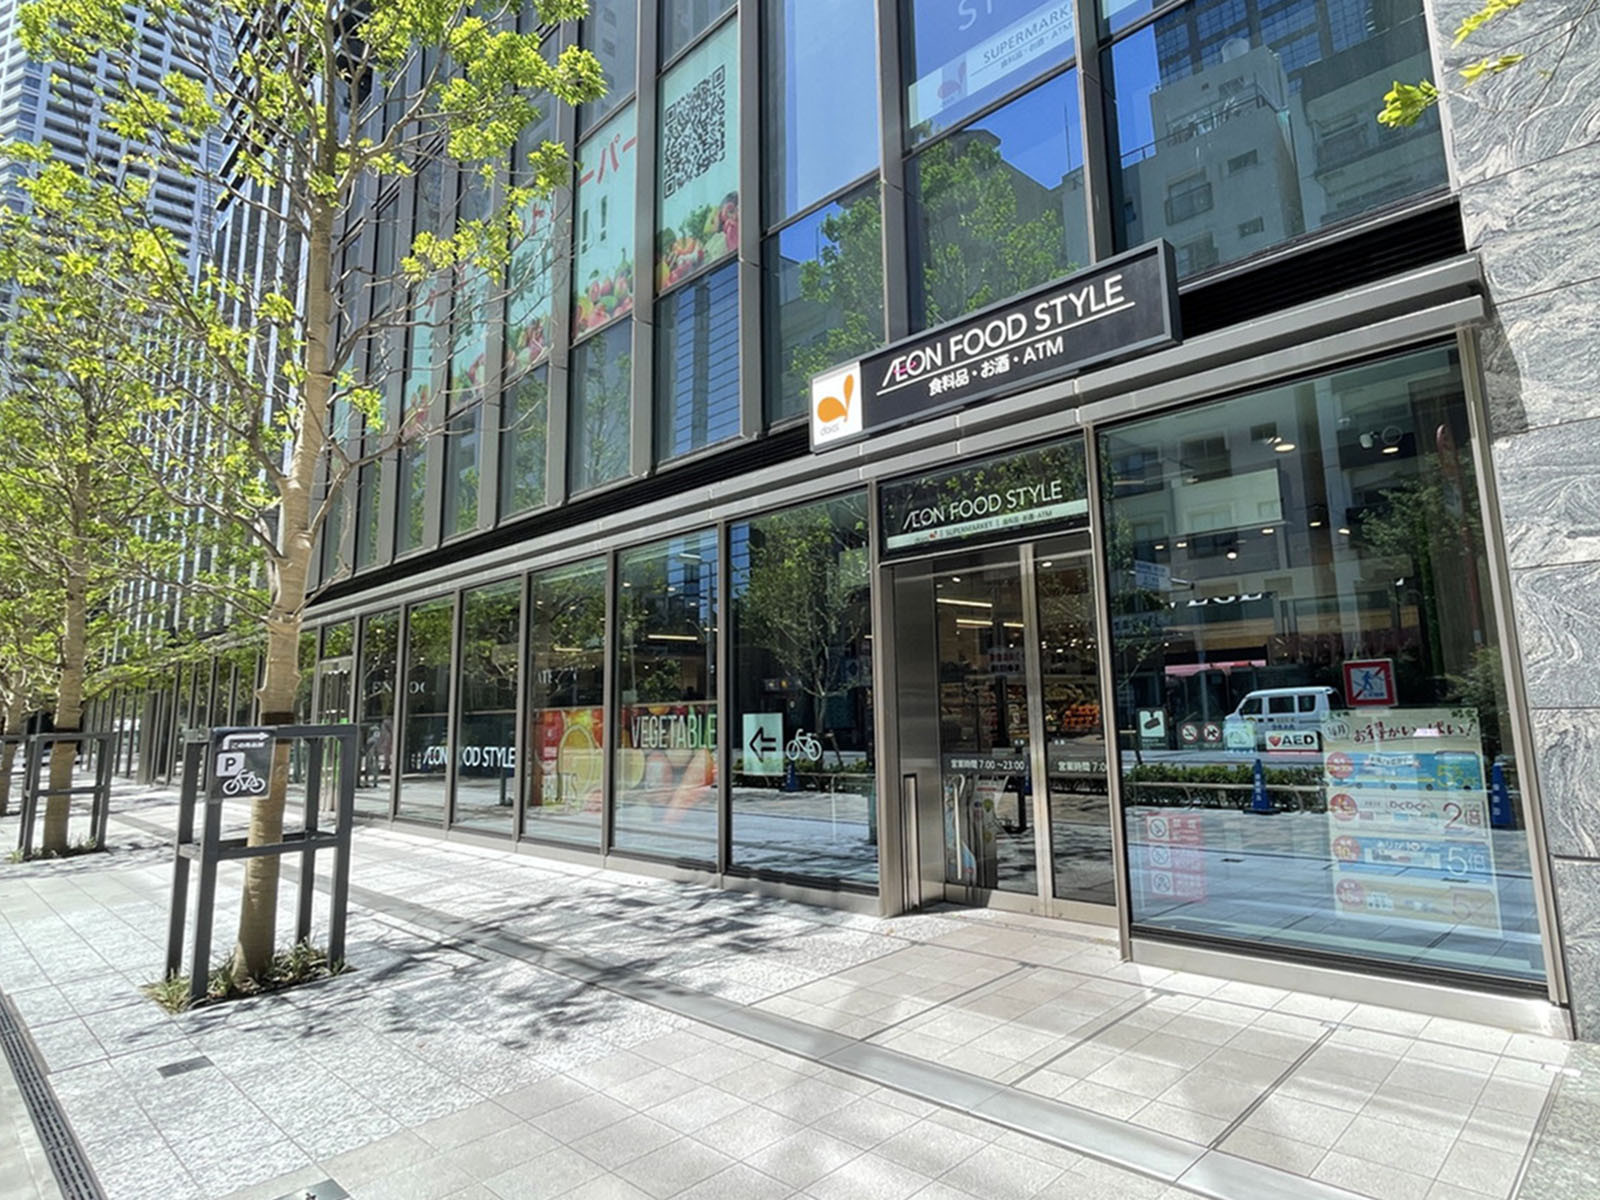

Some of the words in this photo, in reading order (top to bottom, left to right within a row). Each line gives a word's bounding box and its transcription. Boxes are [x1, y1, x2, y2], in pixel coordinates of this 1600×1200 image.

[950, 313, 1028, 362] FOOD
[1035, 274, 1126, 331] STYLE
[950, 493, 1001, 520] FOOD
[1006, 480, 1063, 509] STYLE
[631, 715, 717, 748] VEGETABLE
[1282, 733, 1314, 746] AED
[225, 757, 236, 772] P
[482, 746, 516, 768] STYLE
